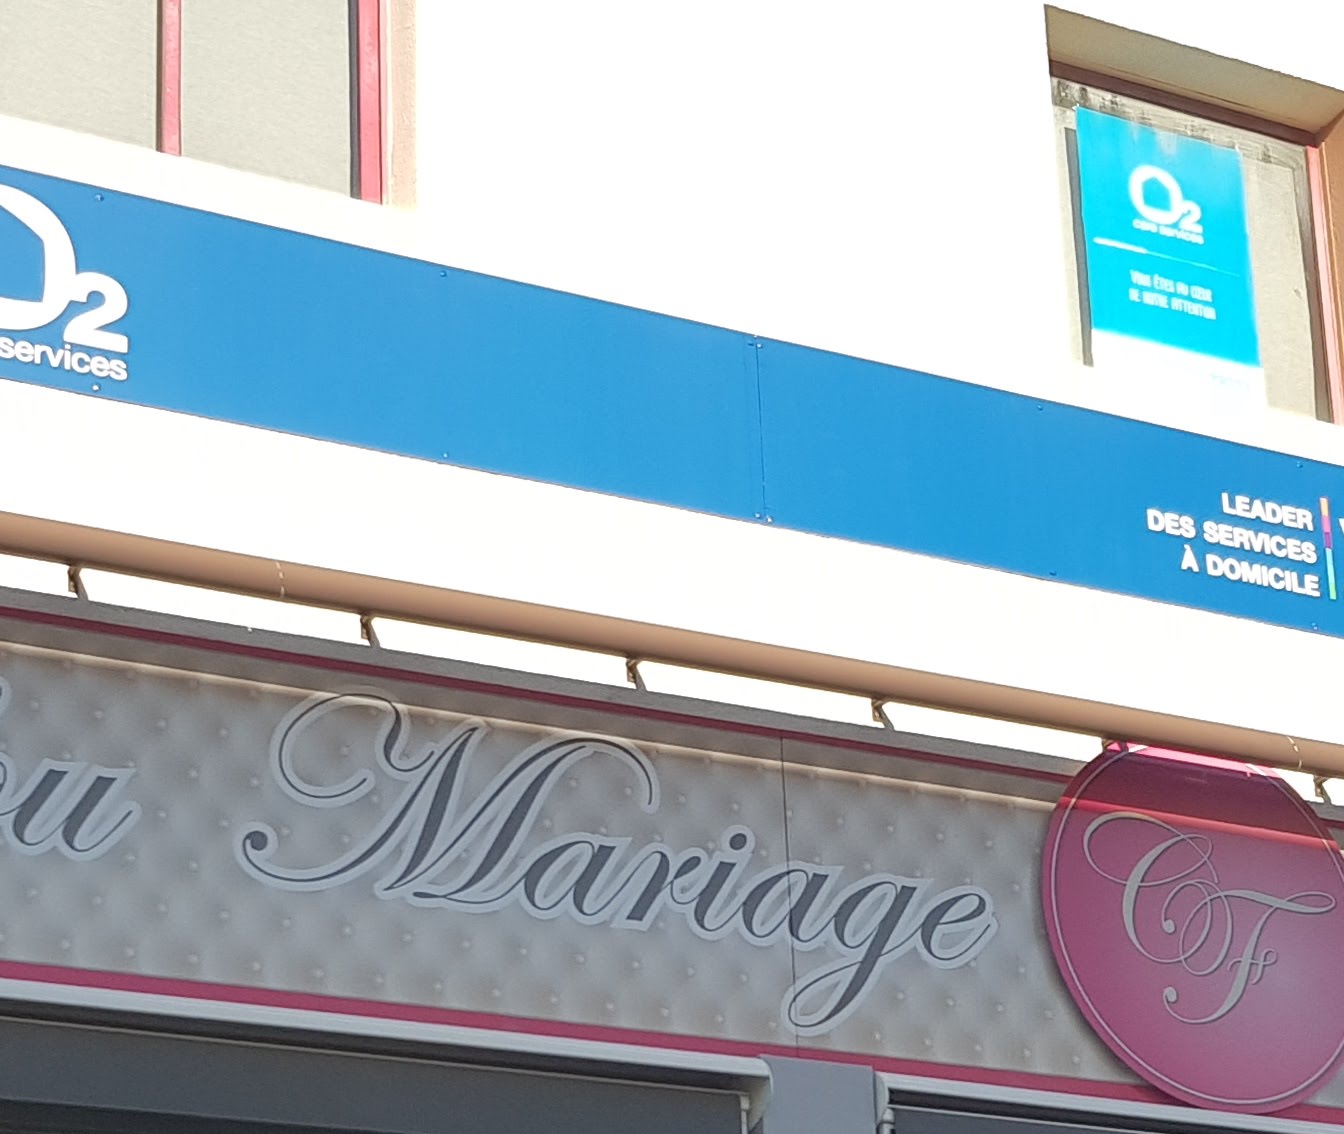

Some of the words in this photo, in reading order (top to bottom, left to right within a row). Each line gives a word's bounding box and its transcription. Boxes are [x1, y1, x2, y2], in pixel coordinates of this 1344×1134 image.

[1146, 509, 1196, 539] DES
[1203, 521, 1318, 564] SERVICES
[1221, 492, 1313, 532] LEADER
[1180, 544, 1199, 573] À
[1206, 554, 1321, 597] DOMICILE
[239, 691, 998, 1031] Mariage
